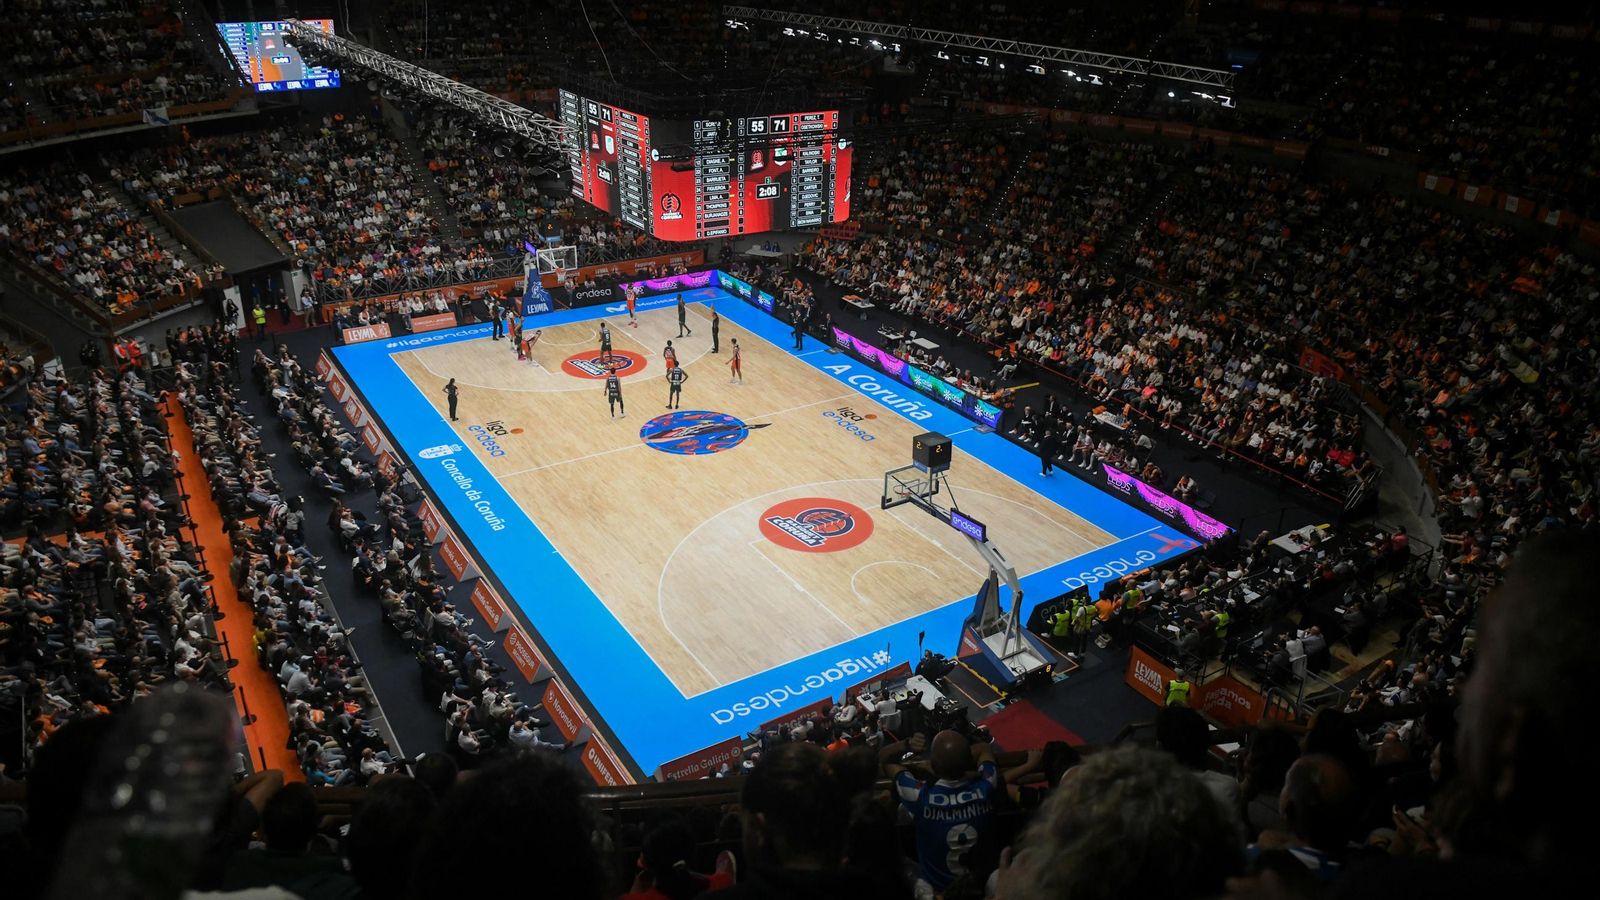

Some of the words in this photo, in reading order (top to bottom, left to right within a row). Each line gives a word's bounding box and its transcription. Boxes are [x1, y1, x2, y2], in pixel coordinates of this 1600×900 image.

[588, 103, 598, 115] 55
[602, 108, 611, 121] 71
[751, 120, 764, 132] 55
[774, 120, 786, 131] 71
[759, 186, 777, 197] 2:08
[576, 287, 612, 300] endesa
[527, 302, 549, 314] LEYMA
[348, 328, 378, 341] LEYMA
[824, 364, 852, 376] A
[848, 373, 934, 421] Coruña
[837, 406, 864, 422] liga
[486, 420, 509, 437] liga
[822, 410, 876, 442] endesa
[468, 424, 506, 458] endesa
[441, 458, 473, 490] Concello
[465, 490, 483, 502] da
[474, 500, 506, 532] Coruña
[952, 515, 982, 537] endesa
[1062, 550, 1156, 590] endesa
[1136, 660, 1163, 689] LEYMA
[710, 650, 892, 726] #ligaendesa
[667, 764, 700, 781] Estrella
[700, 752, 730, 770] Galicia
[928, 788, 984, 806] DIGI
